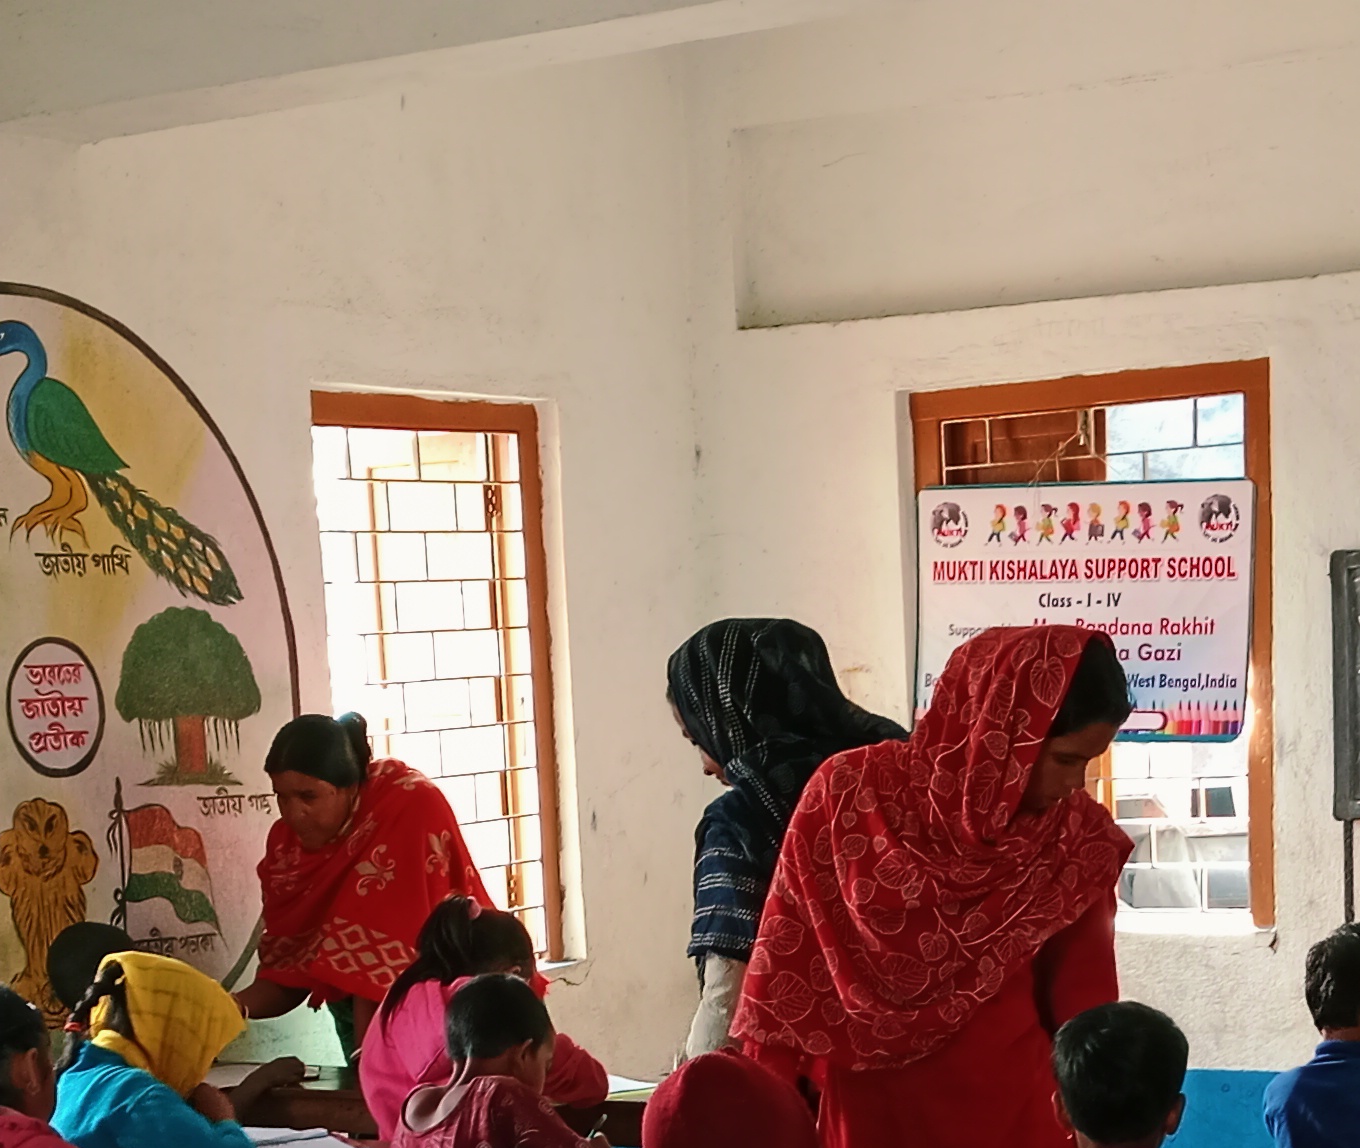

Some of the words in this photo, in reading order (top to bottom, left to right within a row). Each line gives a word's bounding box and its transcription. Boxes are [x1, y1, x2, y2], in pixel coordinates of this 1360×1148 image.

[35, 543, 89, 583] জাতীয়
[932, 560, 985, 582] MUKTI
[990, 559, 1080, 581] KISHALAYA
[1083, 557, 1163, 579] SUPPORT
[1166, 556, 1237, 579] SCHOOL
[1039, 593, 1072, 608] Class
[1106, 592, 1122, 607] IV
[1159, 616, 1216, 635] Rakhit
[1138, 642, 1183, 661] Gazi
[1127, 674, 1156, 688] West
[18, 688, 90, 719] জাতীয়
